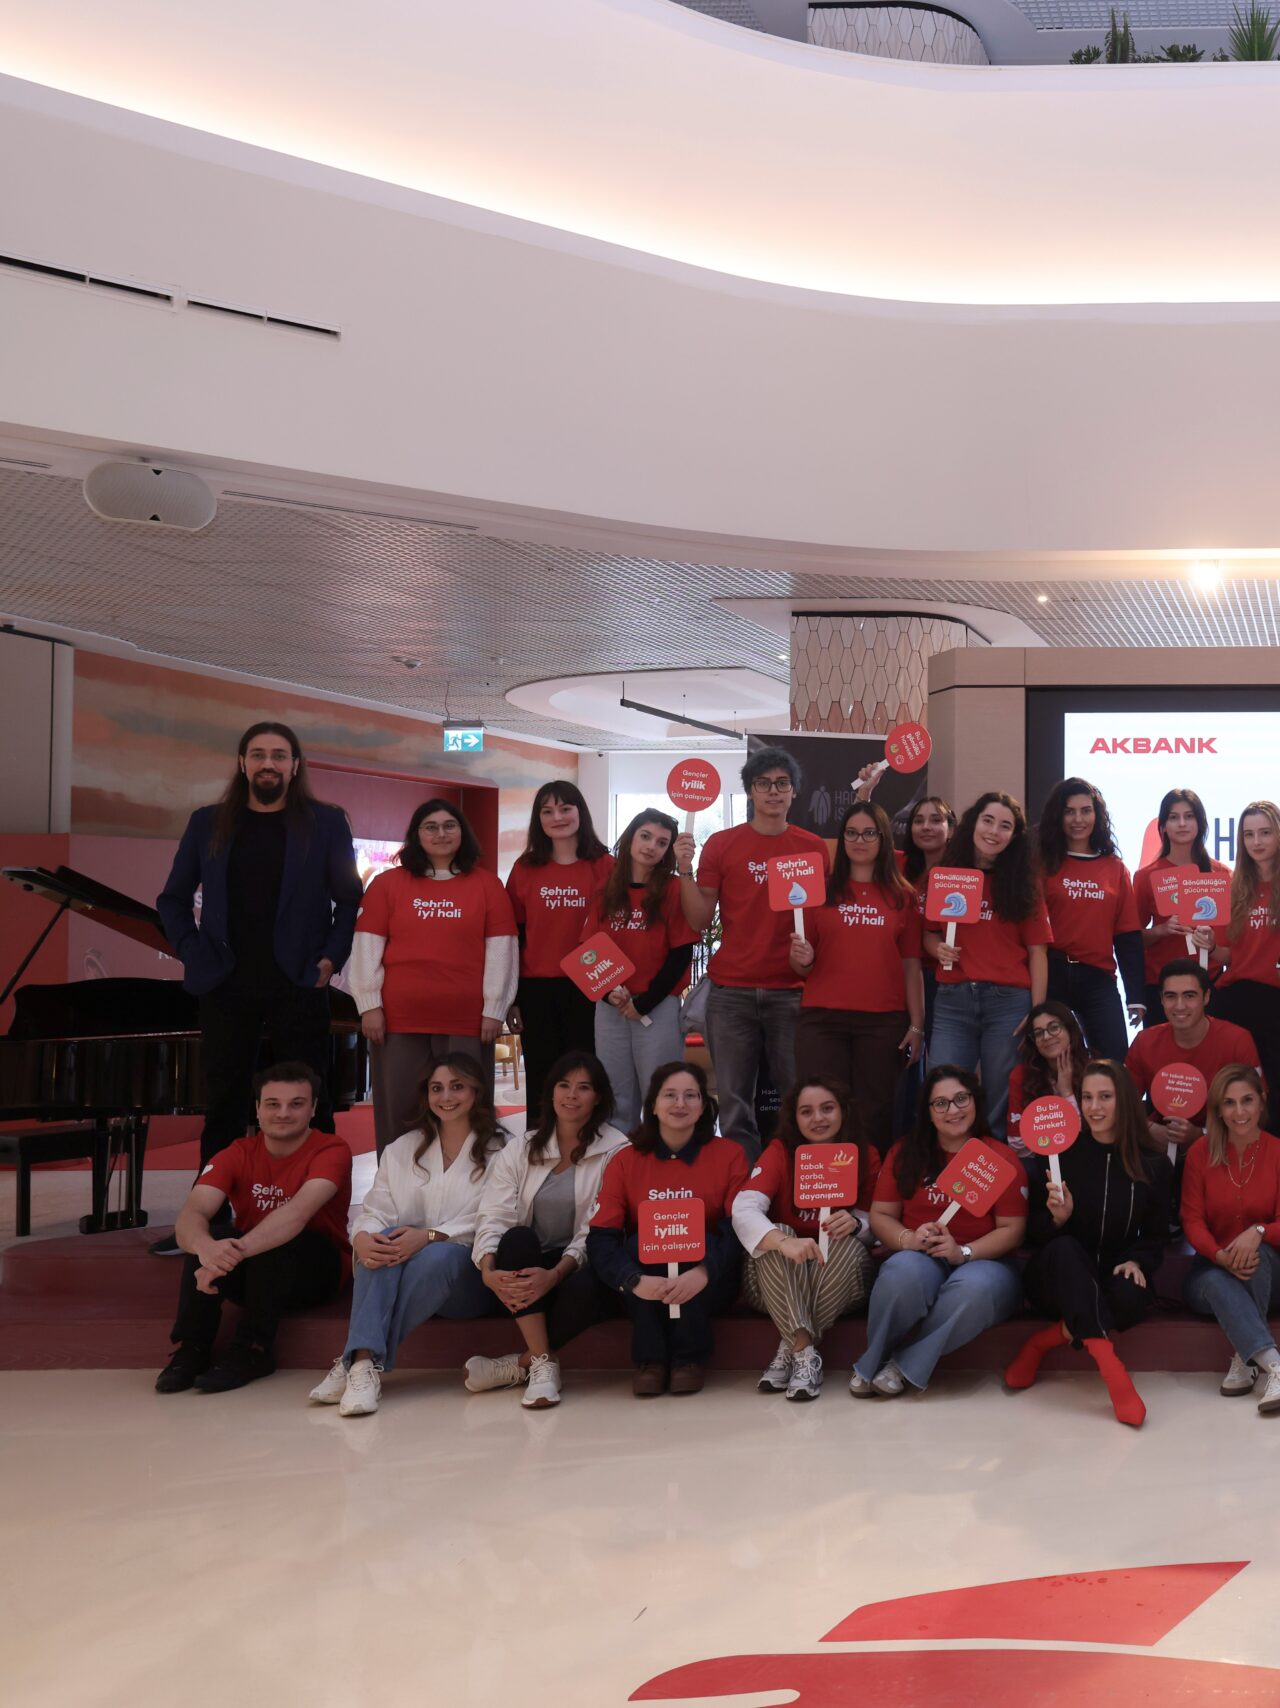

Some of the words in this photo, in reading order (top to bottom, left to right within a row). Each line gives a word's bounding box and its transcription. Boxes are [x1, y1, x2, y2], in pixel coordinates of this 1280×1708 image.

[1089, 737, 1218, 754] AKBANK
[681, 778, 706, 791] iyilik
[776, 859, 808, 871] Şehrin
[782, 868, 795, 880] iyi
[796, 866, 815, 876] hali
[1062, 878, 1098, 889] Şehrin
[540, 886, 579, 898] Şehrin
[1068, 888, 1082, 900] iyi
[1084, 889, 1105, 900] hali
[413, 898, 454, 909] Şehrin
[545, 897, 561, 910] iyi
[563, 897, 586, 907] hali
[838, 903, 878, 915] Şehrin
[417, 907, 435, 920] iyi
[437, 908, 462, 918] hali
[843, 912, 859, 926] iyi
[862, 914, 885, 926] hali
[1250, 915, 1264, 929] iyi
[586, 959, 614, 980] iyilik
[800, 1163, 824, 1171] tabak
[977, 1154, 988, 1166] Bu
[987, 1162, 998, 1173] bir
[799, 1182, 811, 1190] bir
[812, 1182, 838, 1191] dünya
[256, 1195, 276, 1211] iyi
[799, 1192, 844, 1201] dayanışma
[928, 1188, 944, 1205] iyi
[653, 1211, 690, 1221] Gençler
[654, 1223, 688, 1239] iyilik
[642, 1244, 660, 1252] için
[662, 1241, 701, 1252] çalışıyor
